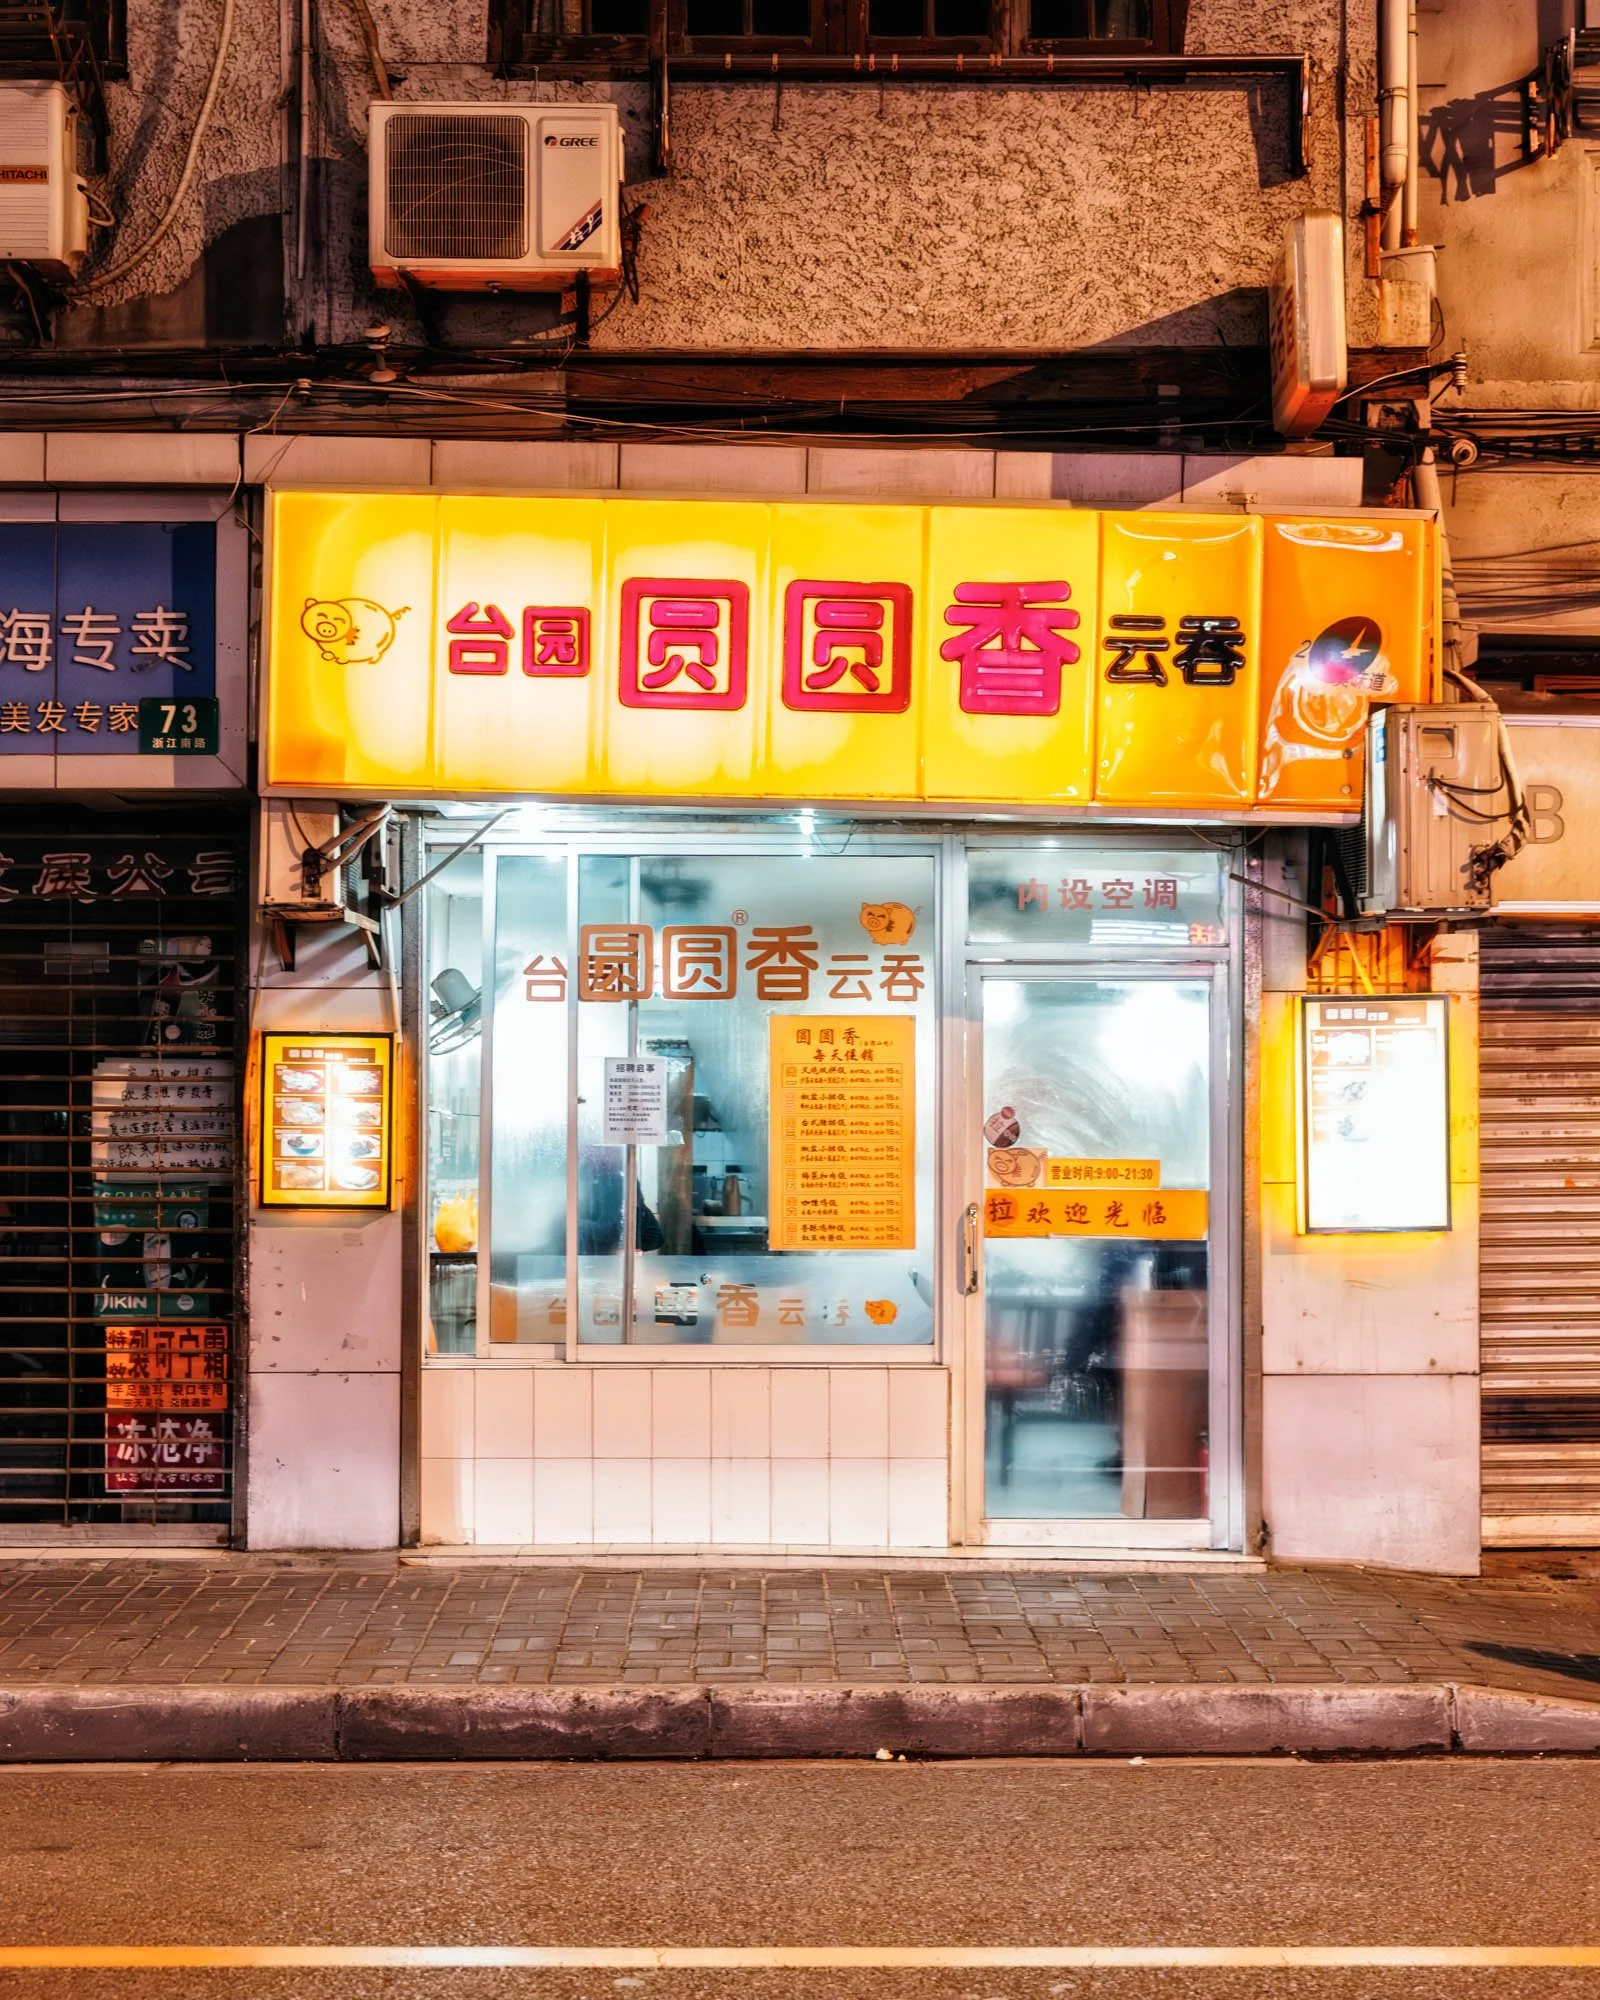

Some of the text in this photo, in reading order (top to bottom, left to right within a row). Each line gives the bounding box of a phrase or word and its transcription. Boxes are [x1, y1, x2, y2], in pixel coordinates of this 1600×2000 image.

[559, 136, 599, 147] GREE
[0, 700, 140, 733] 美发专家
[160, 704, 198, 735] 73
[152, 737, 206, 749] 浙江南路
[1017, 878, 1178, 912] 内设空调
[1051, 1165, 1154, 1181] 营业时间:9:00-21:30
[988, 1198, 1014, 1222] 拉
[1026, 1200, 1168, 1228] 欢迎光临
[117, 1418, 215, 1465] 冻疮净
